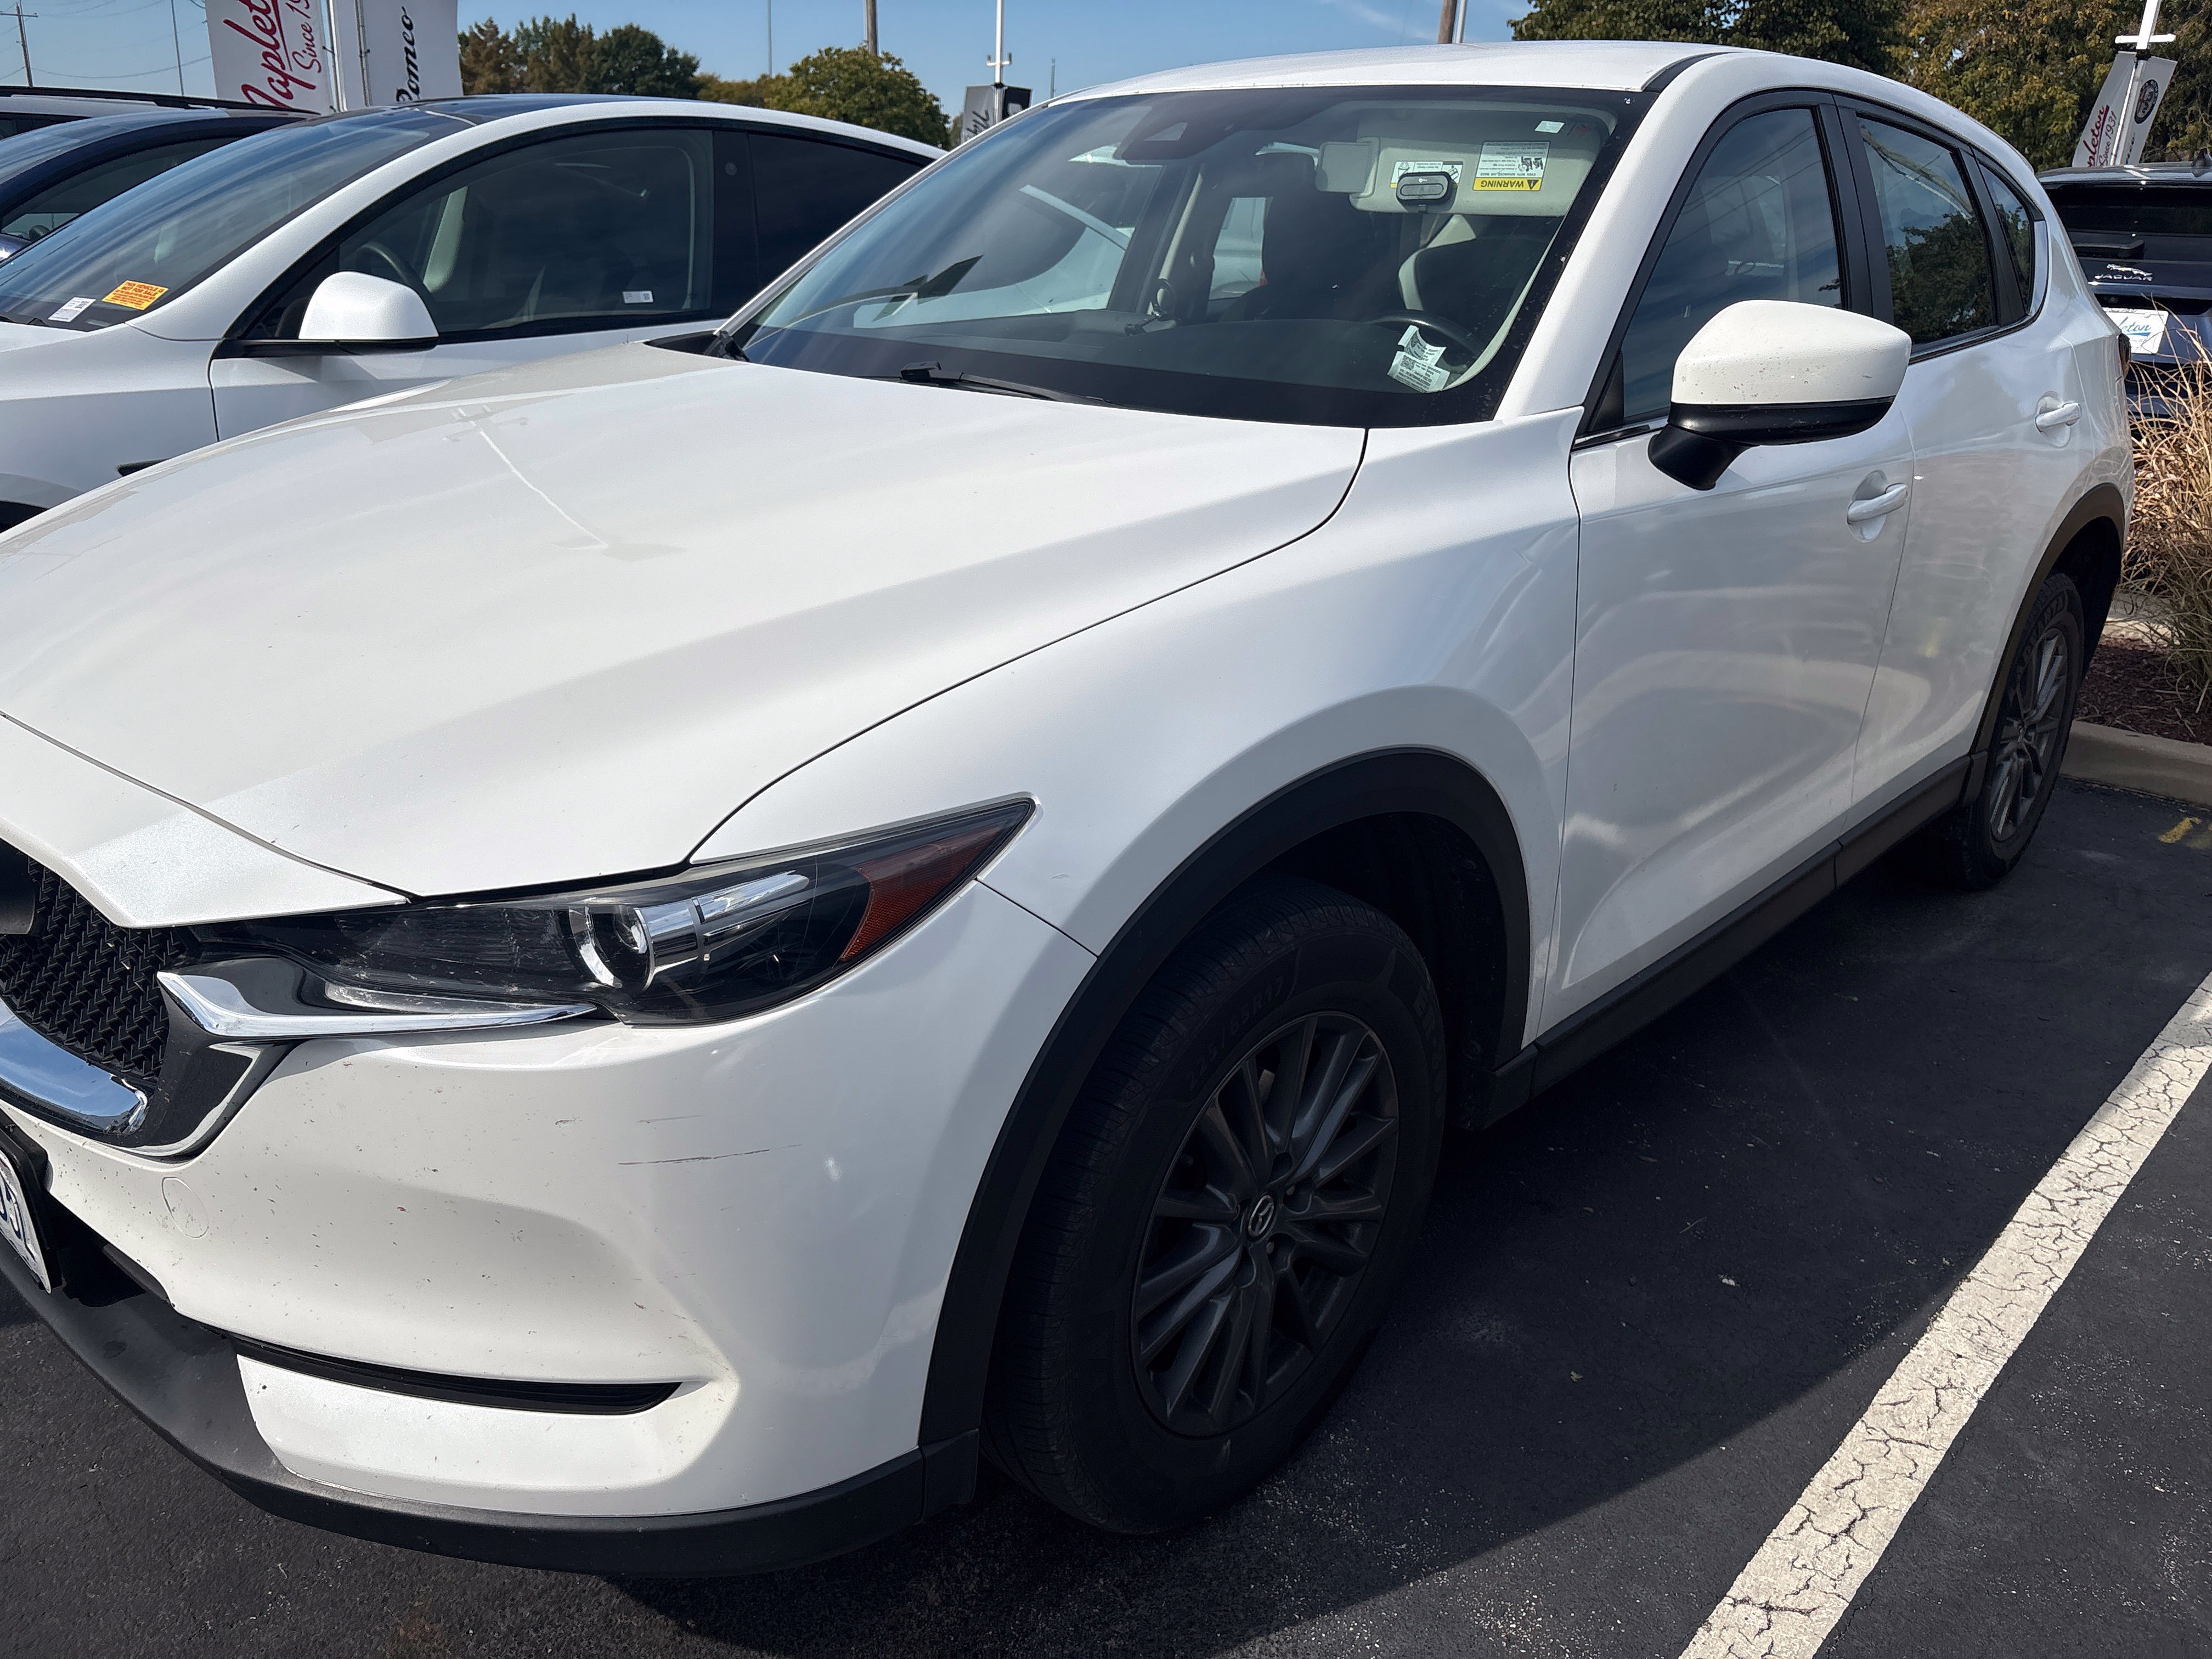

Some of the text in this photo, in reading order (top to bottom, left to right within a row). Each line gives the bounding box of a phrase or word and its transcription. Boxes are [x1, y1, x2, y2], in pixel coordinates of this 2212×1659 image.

[292, 22, 321, 73] Since
[2105, 111, 2117, 139] 1931
[1481, 180, 1524, 188] WARNING
